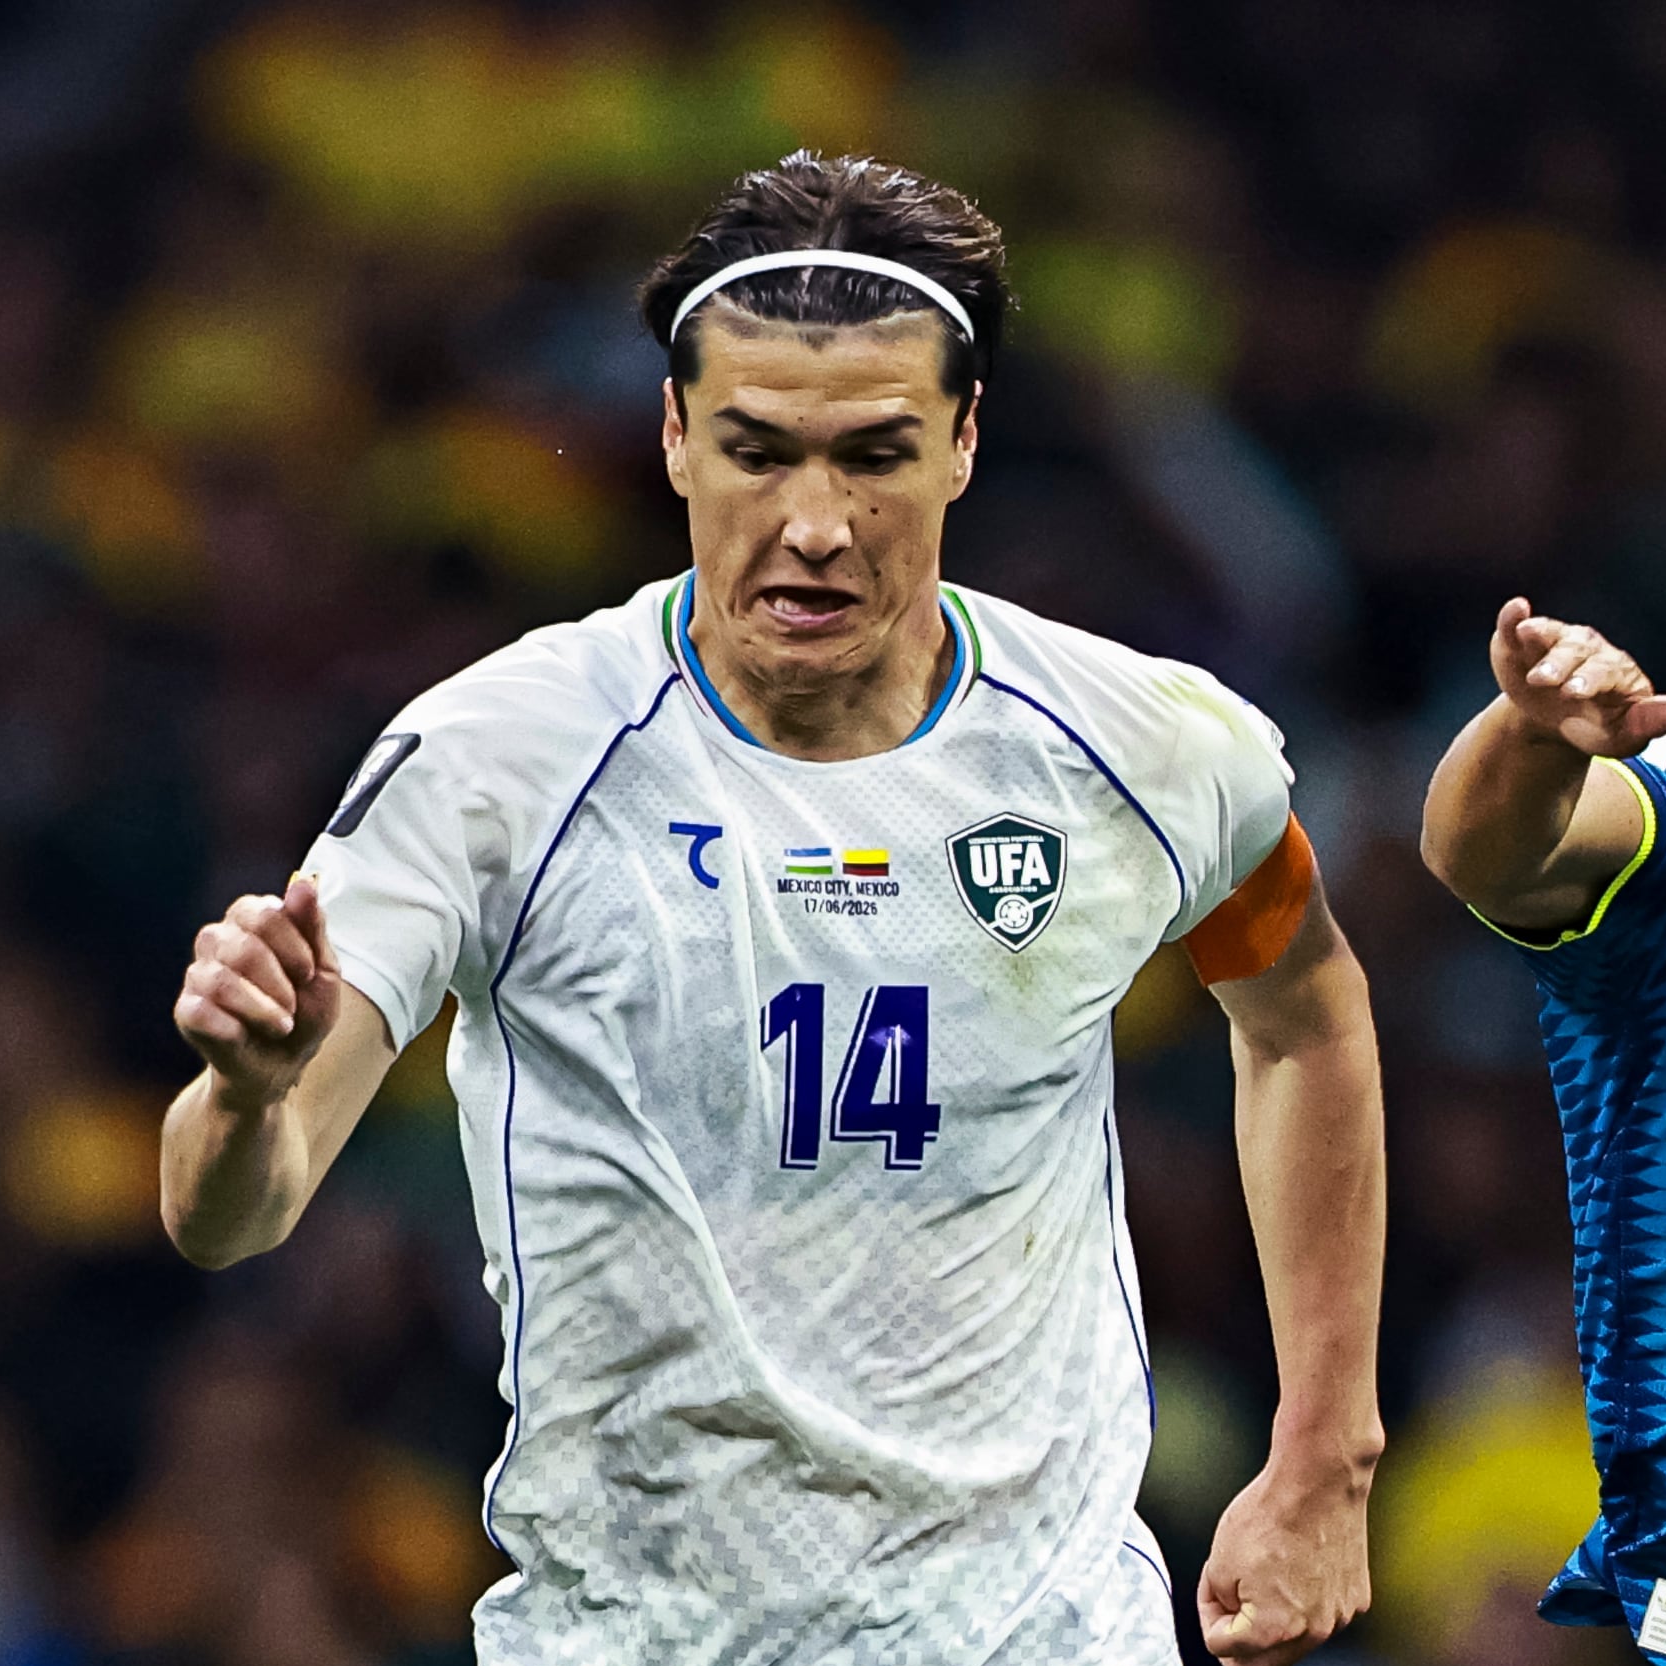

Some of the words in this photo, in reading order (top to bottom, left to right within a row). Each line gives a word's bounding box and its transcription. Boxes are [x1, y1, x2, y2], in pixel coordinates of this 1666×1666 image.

[969, 842, 1052, 888] UFA
[777, 879, 822, 893] MEXICO
[856, 882, 900, 897] MEXICO
[804, 898, 878, 916] 17/06/2026
[760, 983, 941, 1171] 14
